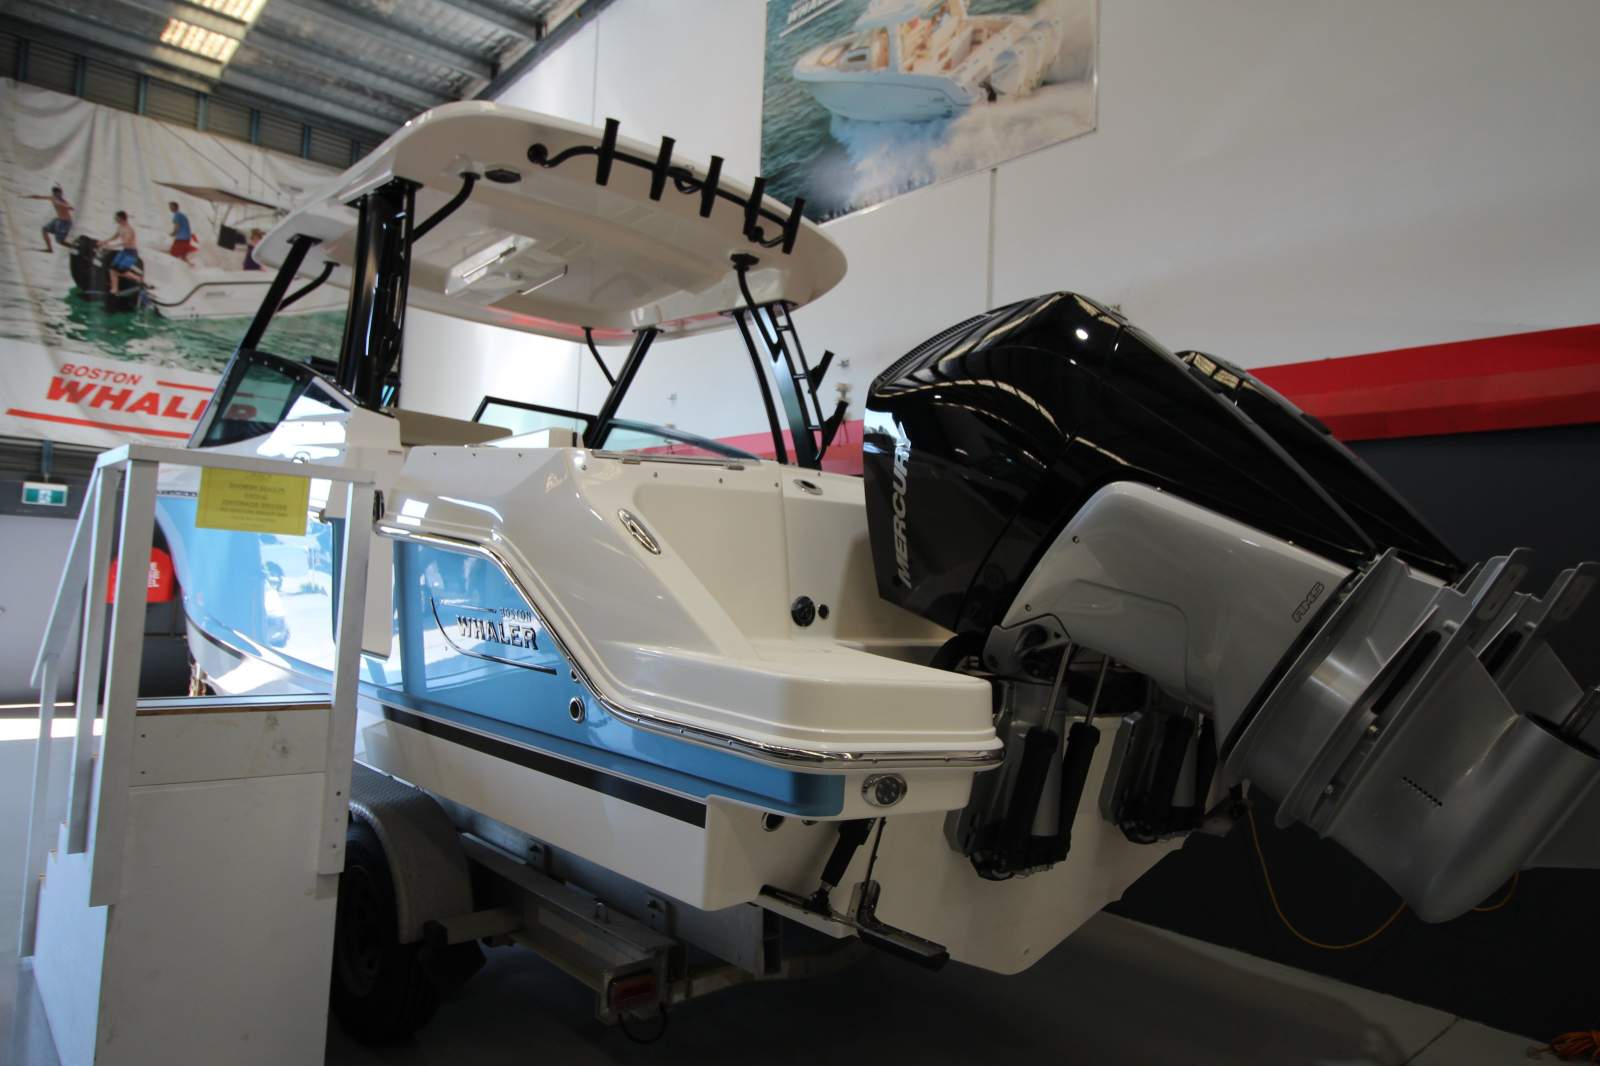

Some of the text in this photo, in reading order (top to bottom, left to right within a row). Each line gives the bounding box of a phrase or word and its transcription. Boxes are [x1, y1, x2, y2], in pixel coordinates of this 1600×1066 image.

[60, 363, 142, 386] BOSTON
[892, 421, 912, 590] MERCURY
[499, 607, 533, 622] BOSTON
[456, 615, 540, 651] WHALER
